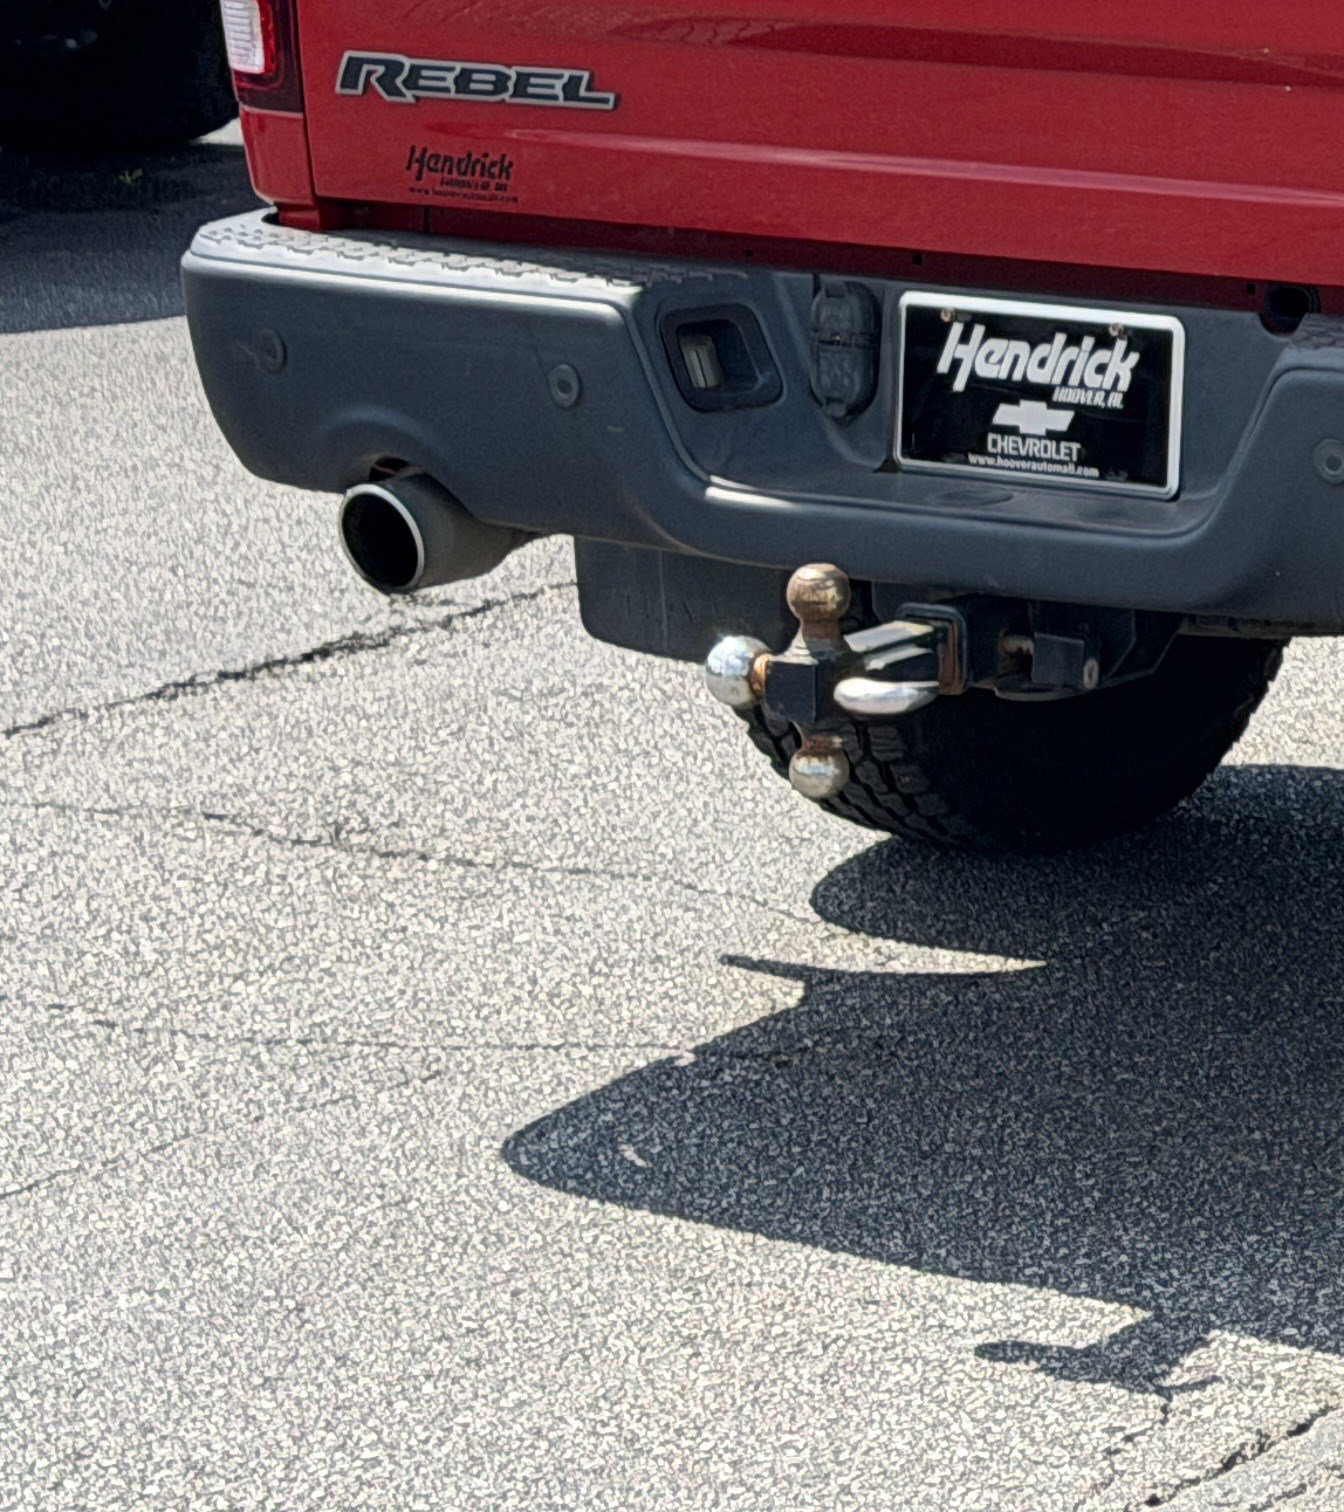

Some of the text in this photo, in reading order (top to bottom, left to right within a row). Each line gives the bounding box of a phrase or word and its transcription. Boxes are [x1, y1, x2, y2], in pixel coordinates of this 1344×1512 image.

[335, 49, 618, 110] REBEL
[405, 144, 513, 181] Hendrick
[937, 321, 1140, 393] Hendrick
[986, 432, 1082, 463] CHEVROLET
